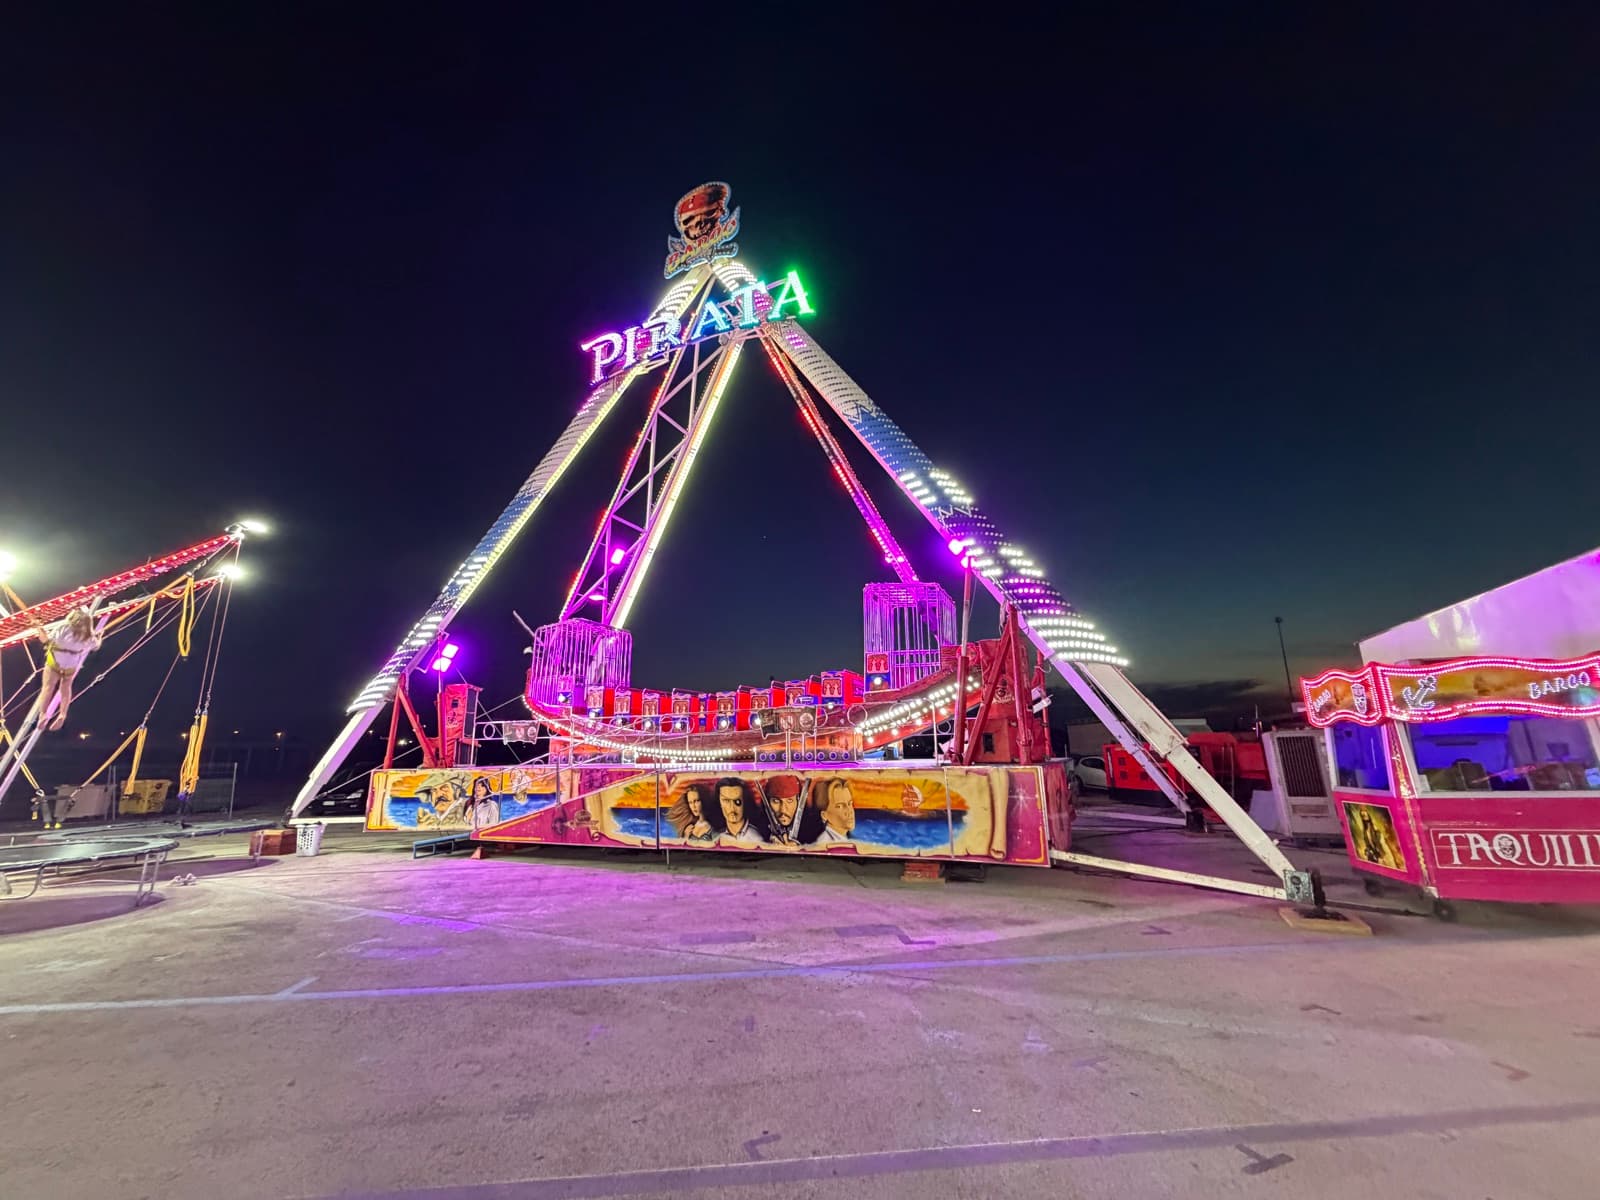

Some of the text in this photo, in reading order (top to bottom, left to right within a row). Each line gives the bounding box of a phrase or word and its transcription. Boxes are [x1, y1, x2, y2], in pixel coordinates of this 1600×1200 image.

[581, 270, 816, 385] PIRATA
[1528, 671, 1591, 700] BARCO
[1438, 833, 1600, 867] TAQUILL
